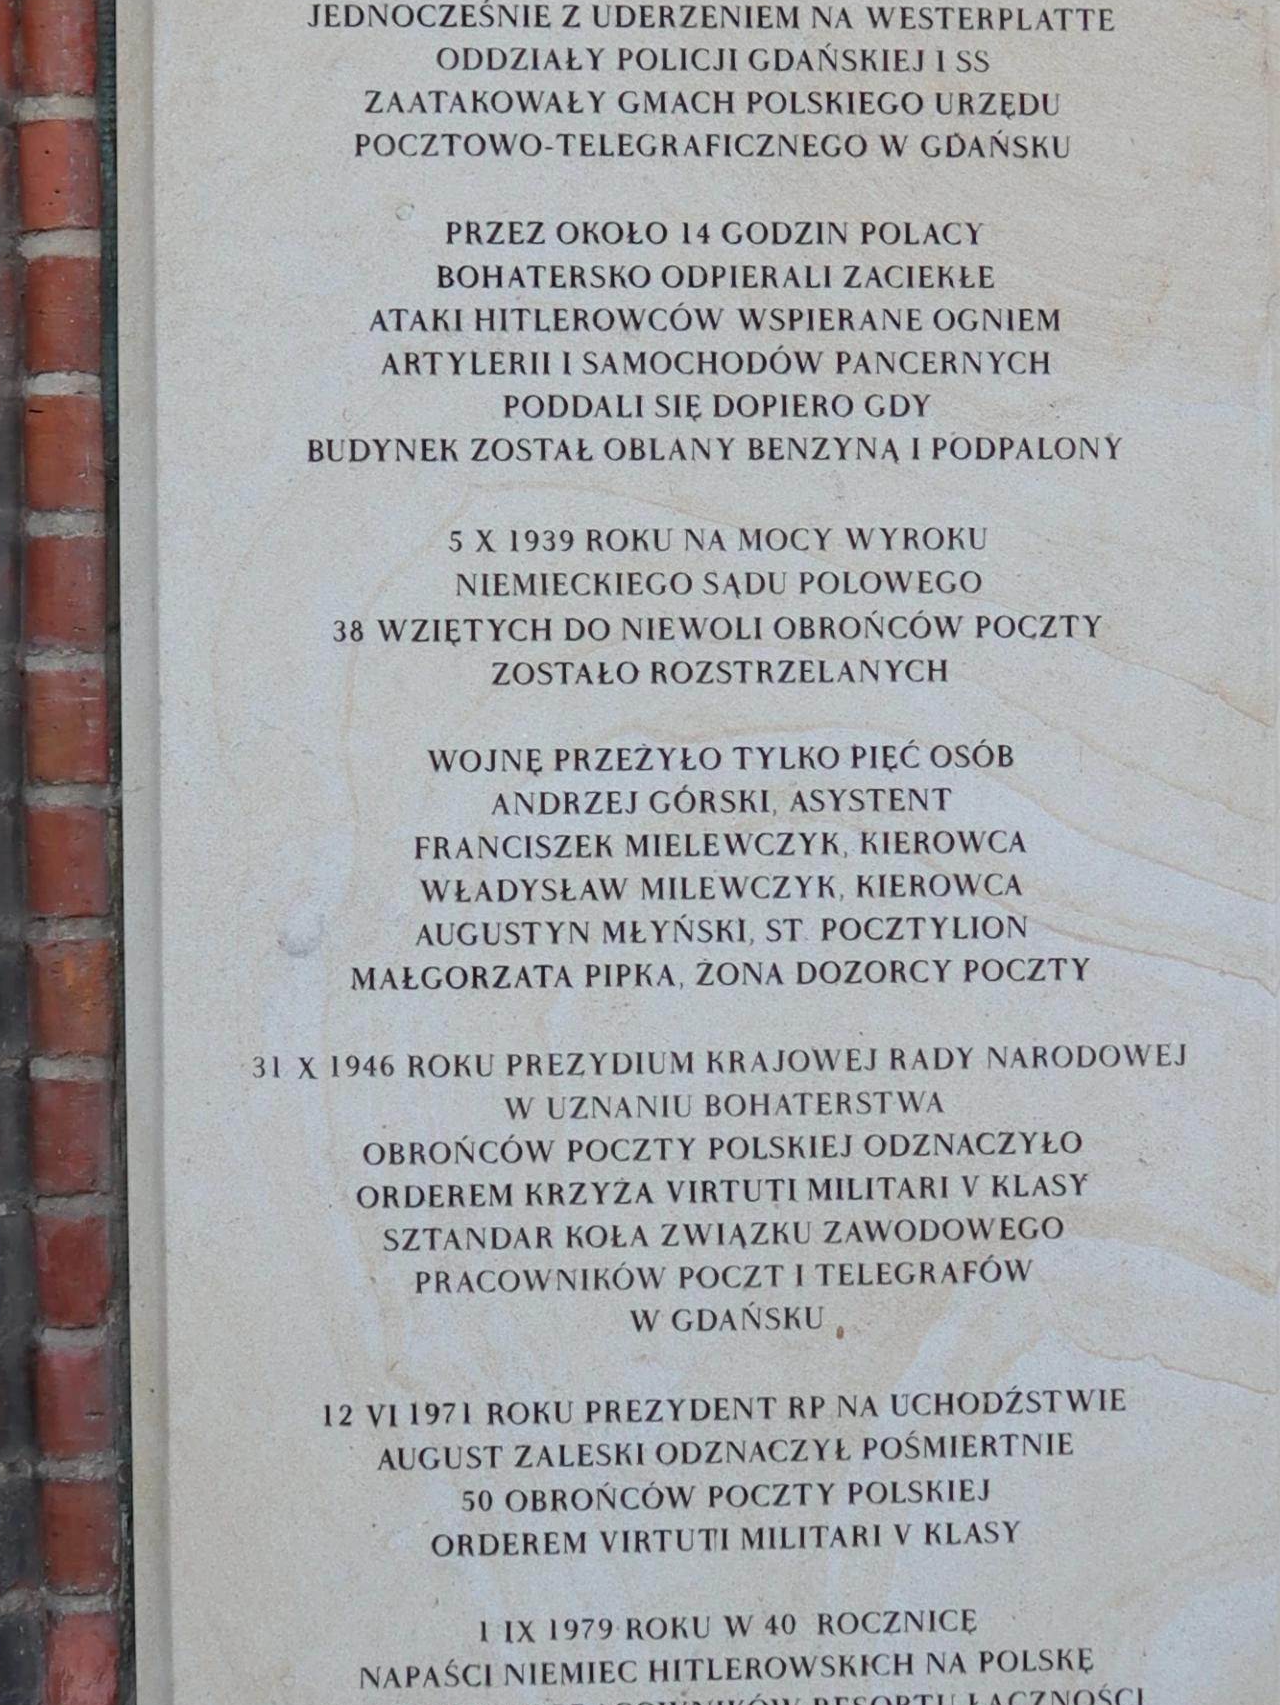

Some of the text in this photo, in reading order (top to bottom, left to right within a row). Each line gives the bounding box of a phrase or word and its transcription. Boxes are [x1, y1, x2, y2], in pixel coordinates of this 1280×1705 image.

[364, 89, 1060, 120] ZAATAKOWAŁY GMACH POLSKIEGO URZĘDU
[354, 129, 1070, 160] POCZTOWO-TELEGRAFICZNEGO W GDAŃSKU
[436, 264, 995, 289] BOHATERSKO ODPIERALI ZACIEKŁE
[369, 302, 1061, 333] ATAKI HITLEROWCÓW WSPIERANE OGNIEM
[503, 393, 931, 423] PODDALI SIĘ DOPIERO GDY
[456, 570, 983, 600] NIEMIECKIEGO SĄDU POLOWEGO
[491, 658, 948, 686] ZOSTAŁO ROZSTRZELANYCH
[427, 738, 1015, 777] WOJNĘ PRZEŻYŁO TYLKO PIĘĆ OSÓB
[491, 784, 953, 816] ANDRZEJ GÓRSKI, ASYSTENT
[414, 829, 1027, 860] FRANCISZEK MIELEWCZYK, KIEROWCA
[420, 872, 1023, 903] WŁADYSŁAW MILEWCZYK, KIEROWCA
[350, 957, 1091, 992] MAŁGORZATA PIPKA, ŻONA DOZORCY POCZTY
[504, 1090, 944, 1120] W UZNANIU BOHATERSTWA
[362, 1130, 1083, 1166] OBROŃCÓW POCZTY POLSKIEJ ODZNACZYŁO
[383, 1215, 1064, 1252] SZTANDAR KOŁA ZWIĄZKU ZAWODOWEGO
[629, 1301, 824, 1333] W GDAŃSKU
[377, 1430, 1074, 1471] AUGUST ZALESKI ODZNACZYŁ POŚMIERTNIE
[461, 1478, 990, 1513] 50 OBROŃCÓW POCZTY POLSKIEJ
[360, 1647, 1094, 1690] NAPAŚCI NIEMIEC HITLEROWSKICH NA POLSKĘ
